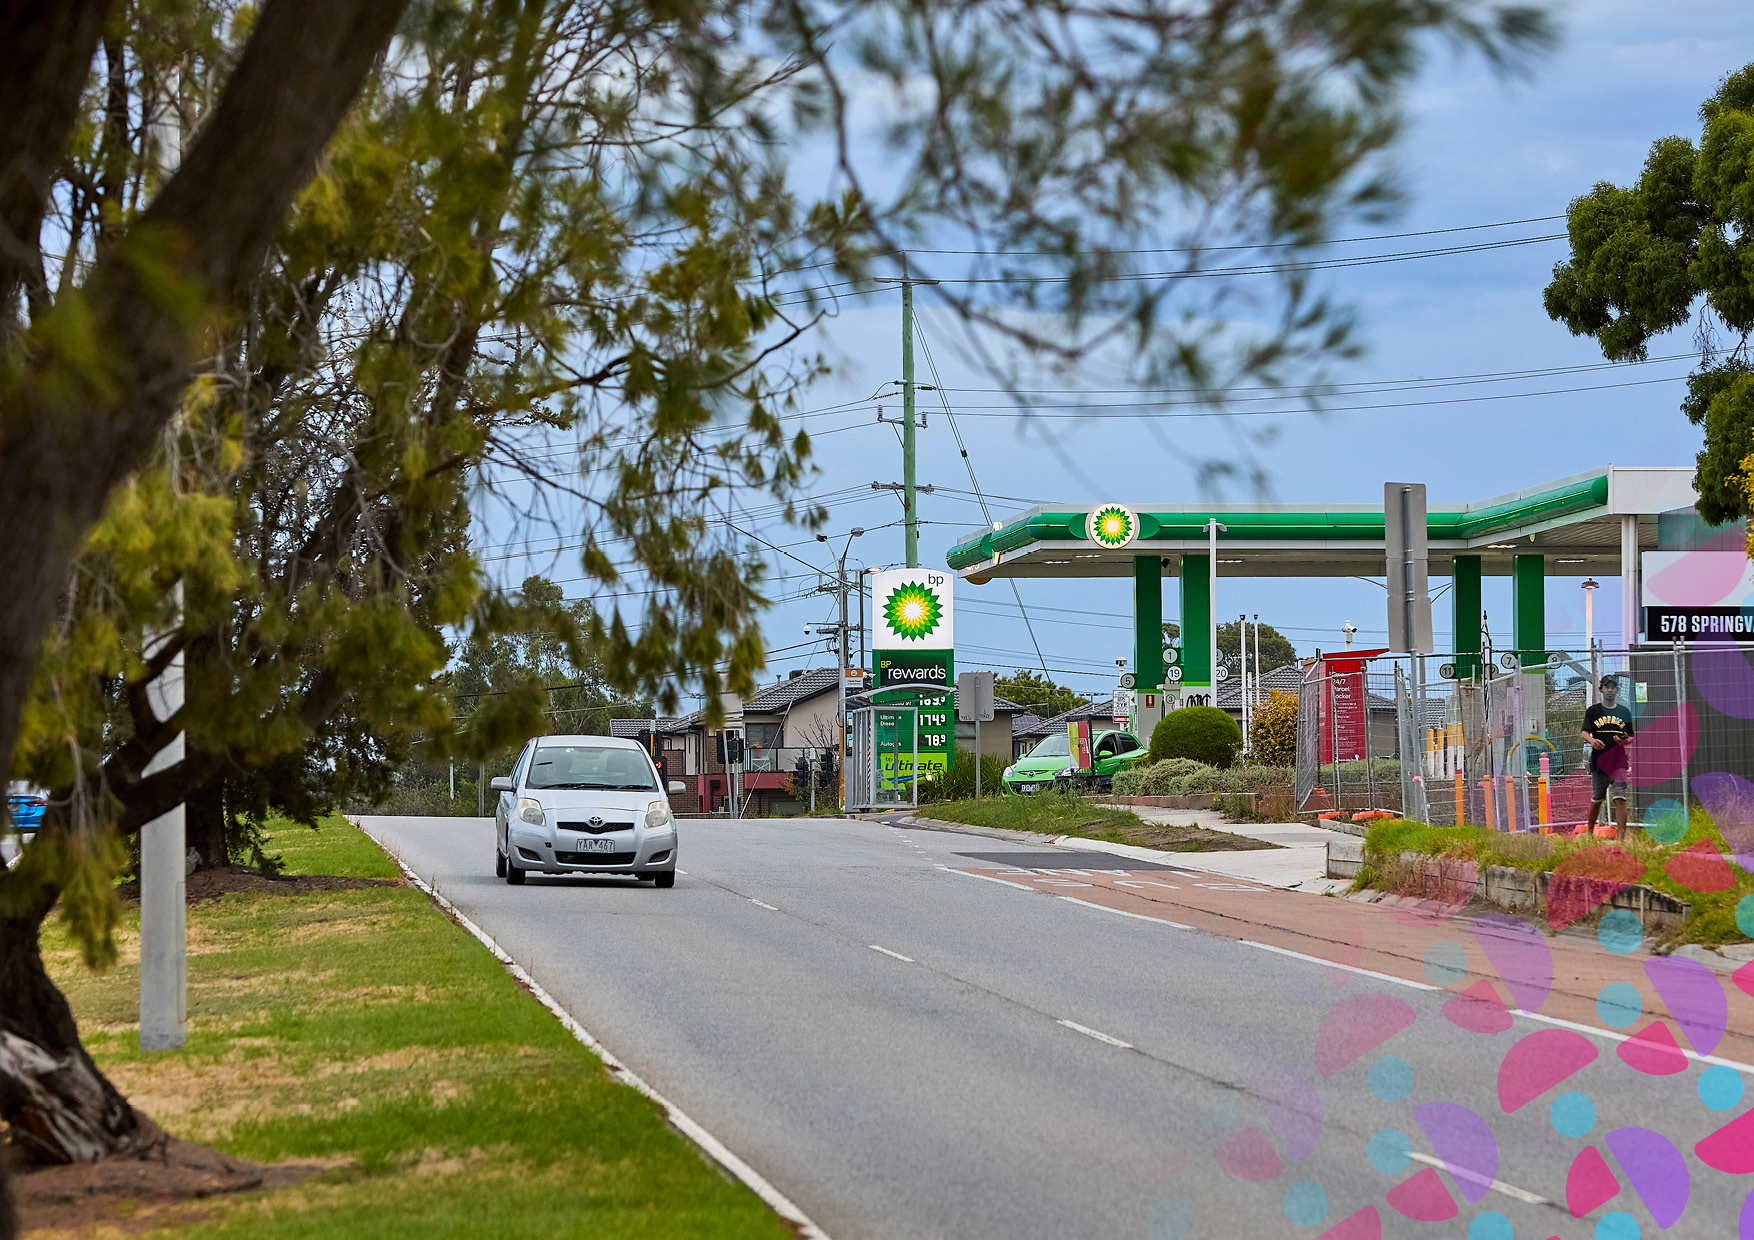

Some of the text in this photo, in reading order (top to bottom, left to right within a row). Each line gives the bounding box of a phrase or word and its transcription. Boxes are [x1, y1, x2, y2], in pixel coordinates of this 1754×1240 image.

[928, 573, 944, 587] bp
[1661, 615, 1754, 633] 578 SPRINGV
[880, 660, 892, 668] BP
[1507, 657, 1513, 666] 7
[888, 664, 947, 680] rewards
[1170, 669, 1180, 678] 19
[1217, 669, 1227, 678] 20
[1443, 667, 1452, 676] 11
[1125, 676, 1131, 686] 5
[885, 759, 943, 771] utimate
[578, 840, 614, 851] YAR 467
